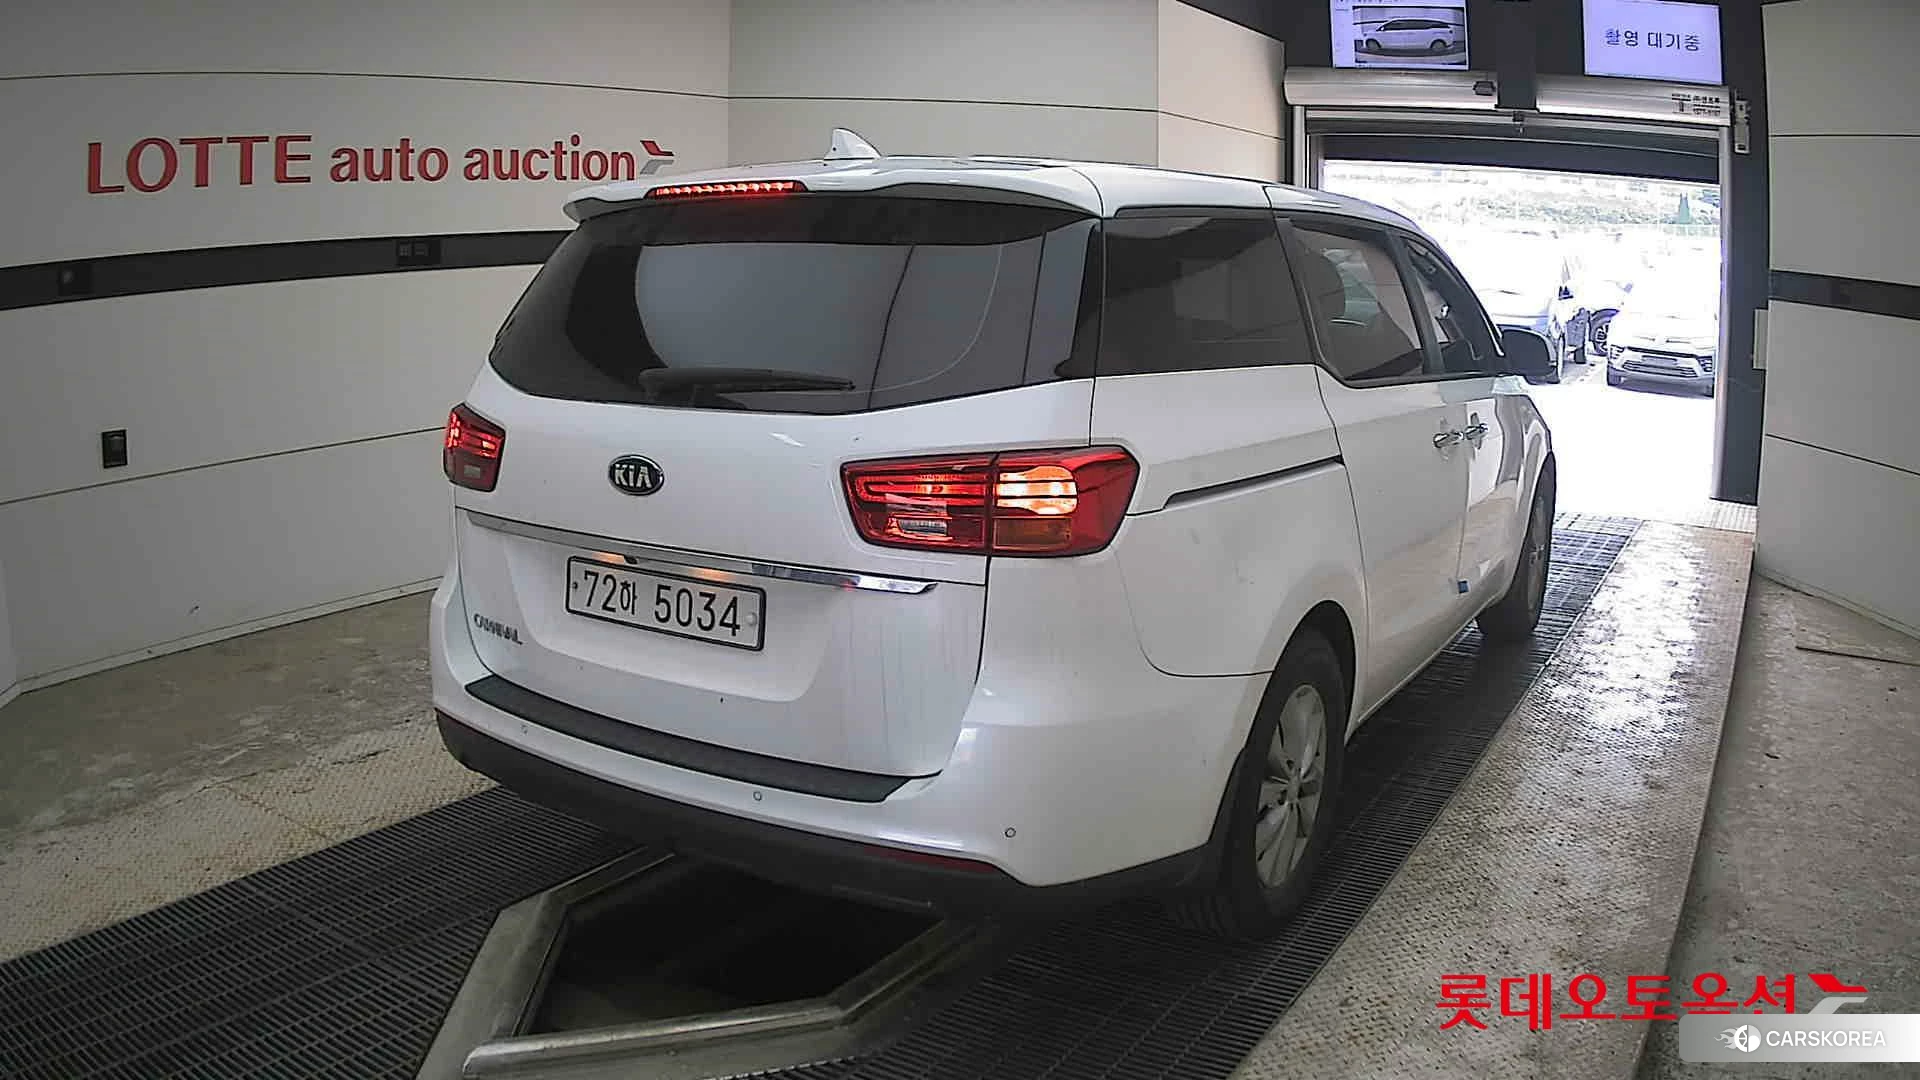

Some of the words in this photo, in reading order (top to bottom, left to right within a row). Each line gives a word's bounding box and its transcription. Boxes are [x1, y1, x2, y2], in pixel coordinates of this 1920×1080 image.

[1647, 31, 1701, 52] 대기중
[87, 134, 313, 195] LOTTE
[330, 137, 450, 183] auto
[463, 133, 637, 182] auction
[613, 462, 653, 489] KIA
[583, 569, 639, 616] 72하
[654, 583, 741, 637] 5034
